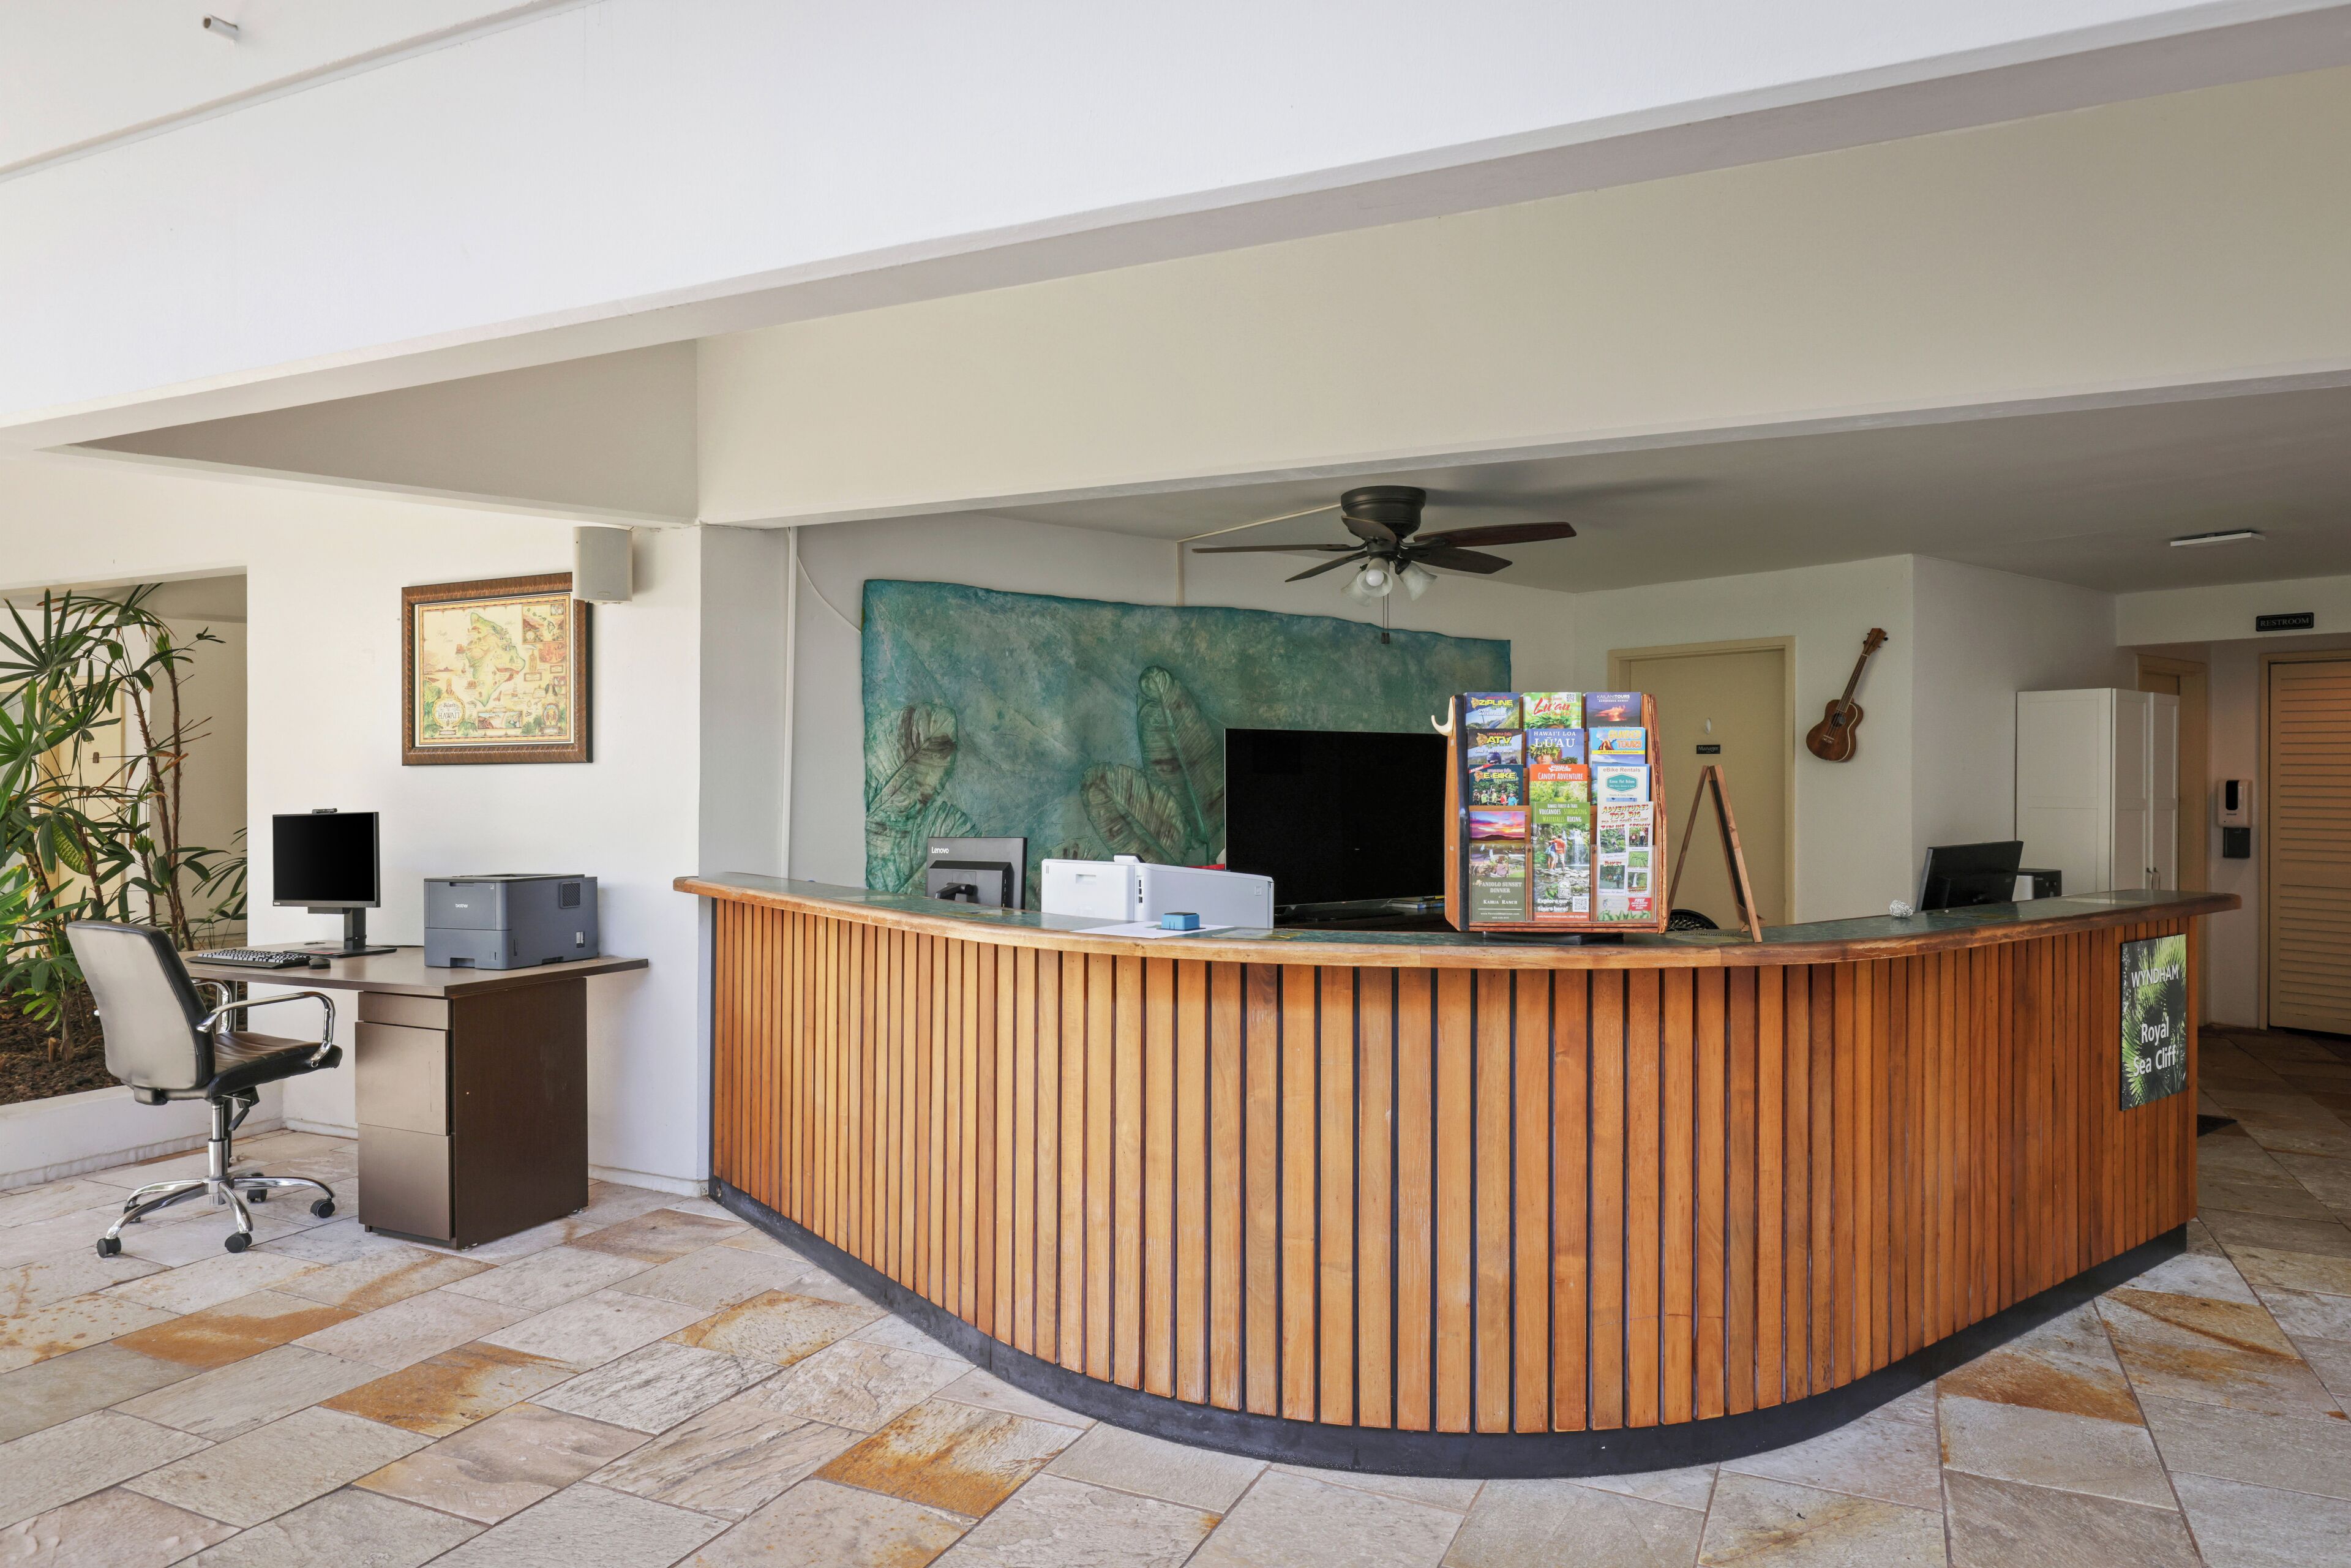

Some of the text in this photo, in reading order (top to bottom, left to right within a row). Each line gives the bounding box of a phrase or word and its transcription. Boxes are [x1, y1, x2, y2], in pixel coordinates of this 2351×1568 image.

[2260, 618, 2309, 626] RESTROOM
[1608, 729, 1642, 739] GUIDED
[1616, 740, 1643, 748] TOURS
[2131, 964, 2178, 988] WYNDHAM
[2141, 1016, 2169, 1046] Royal
[2134, 1045, 2177, 1076] Sea Cliff
